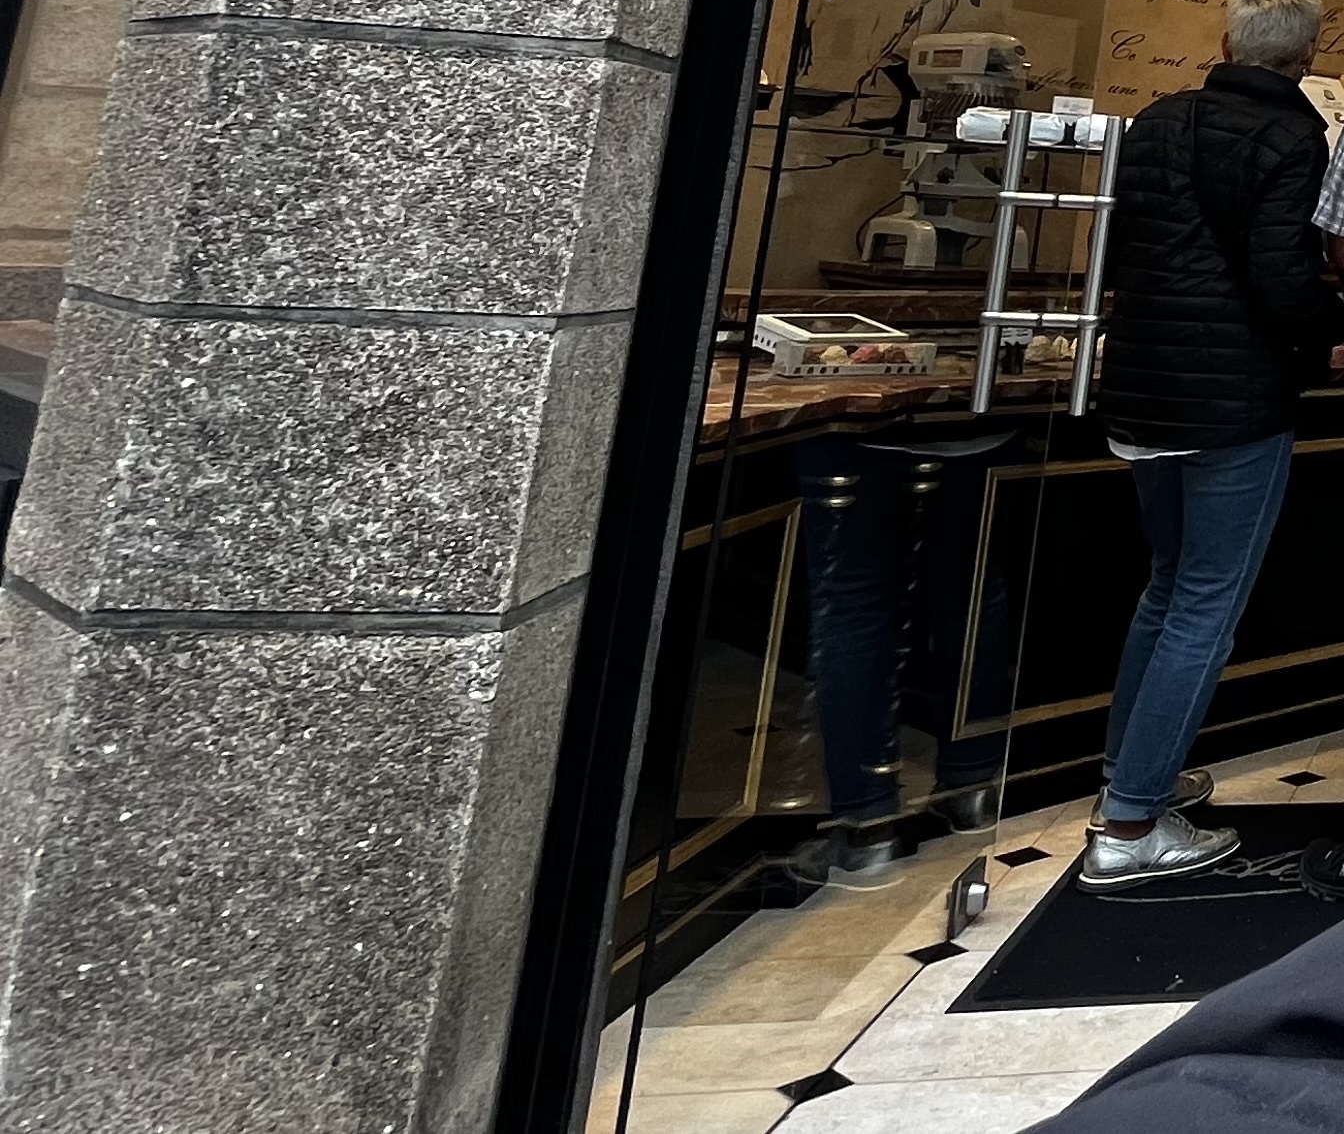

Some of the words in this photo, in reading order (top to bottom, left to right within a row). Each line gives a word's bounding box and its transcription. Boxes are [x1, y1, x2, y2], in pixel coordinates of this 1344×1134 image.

[1110, 29, 1147, 61] Ce
[1149, 56, 1188, 68] sont
[1107, 83, 1139, 96] une
